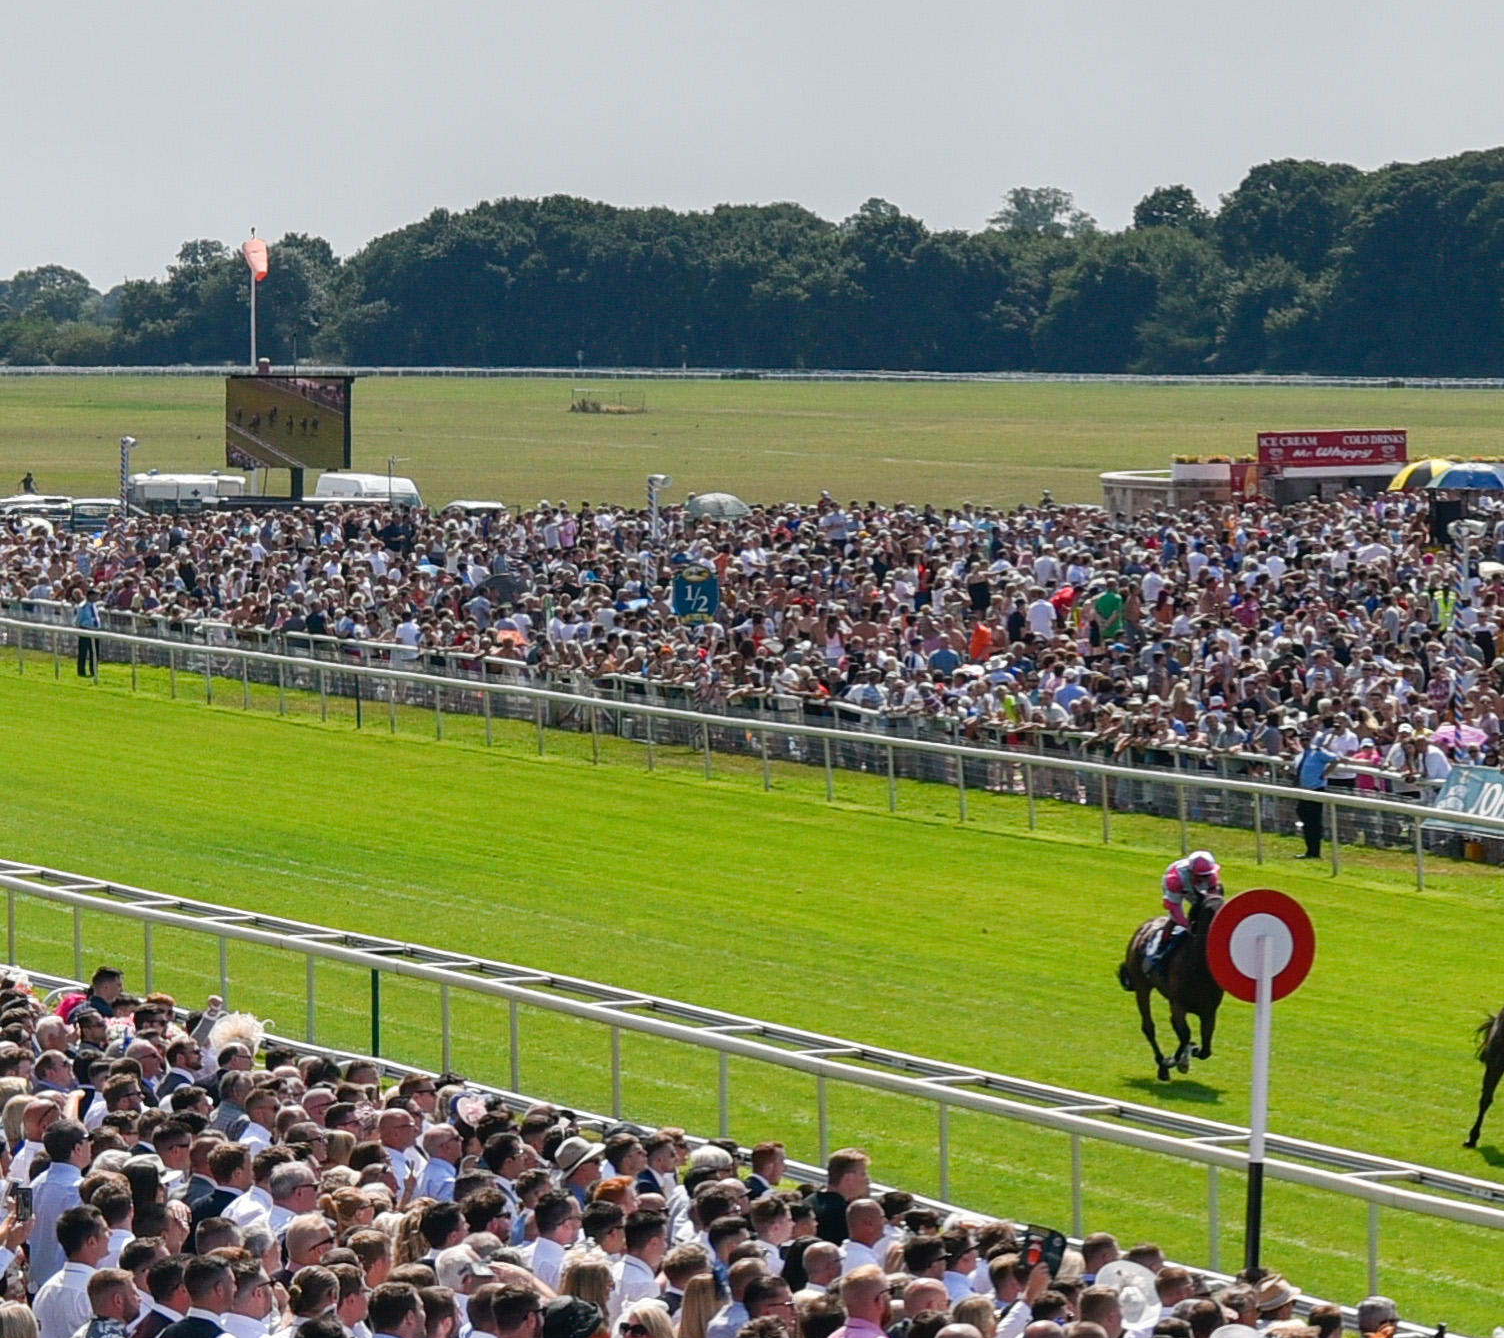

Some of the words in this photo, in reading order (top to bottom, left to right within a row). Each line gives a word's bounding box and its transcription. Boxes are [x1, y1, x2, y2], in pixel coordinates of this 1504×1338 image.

[1259, 437, 1277, 447] ICE
[1280, 436, 1318, 447] CREAM
[1342, 435, 1369, 445] COLD
[1371, 434, 1406, 444] DRINKS
[1315, 446, 1374, 459] Whippy
